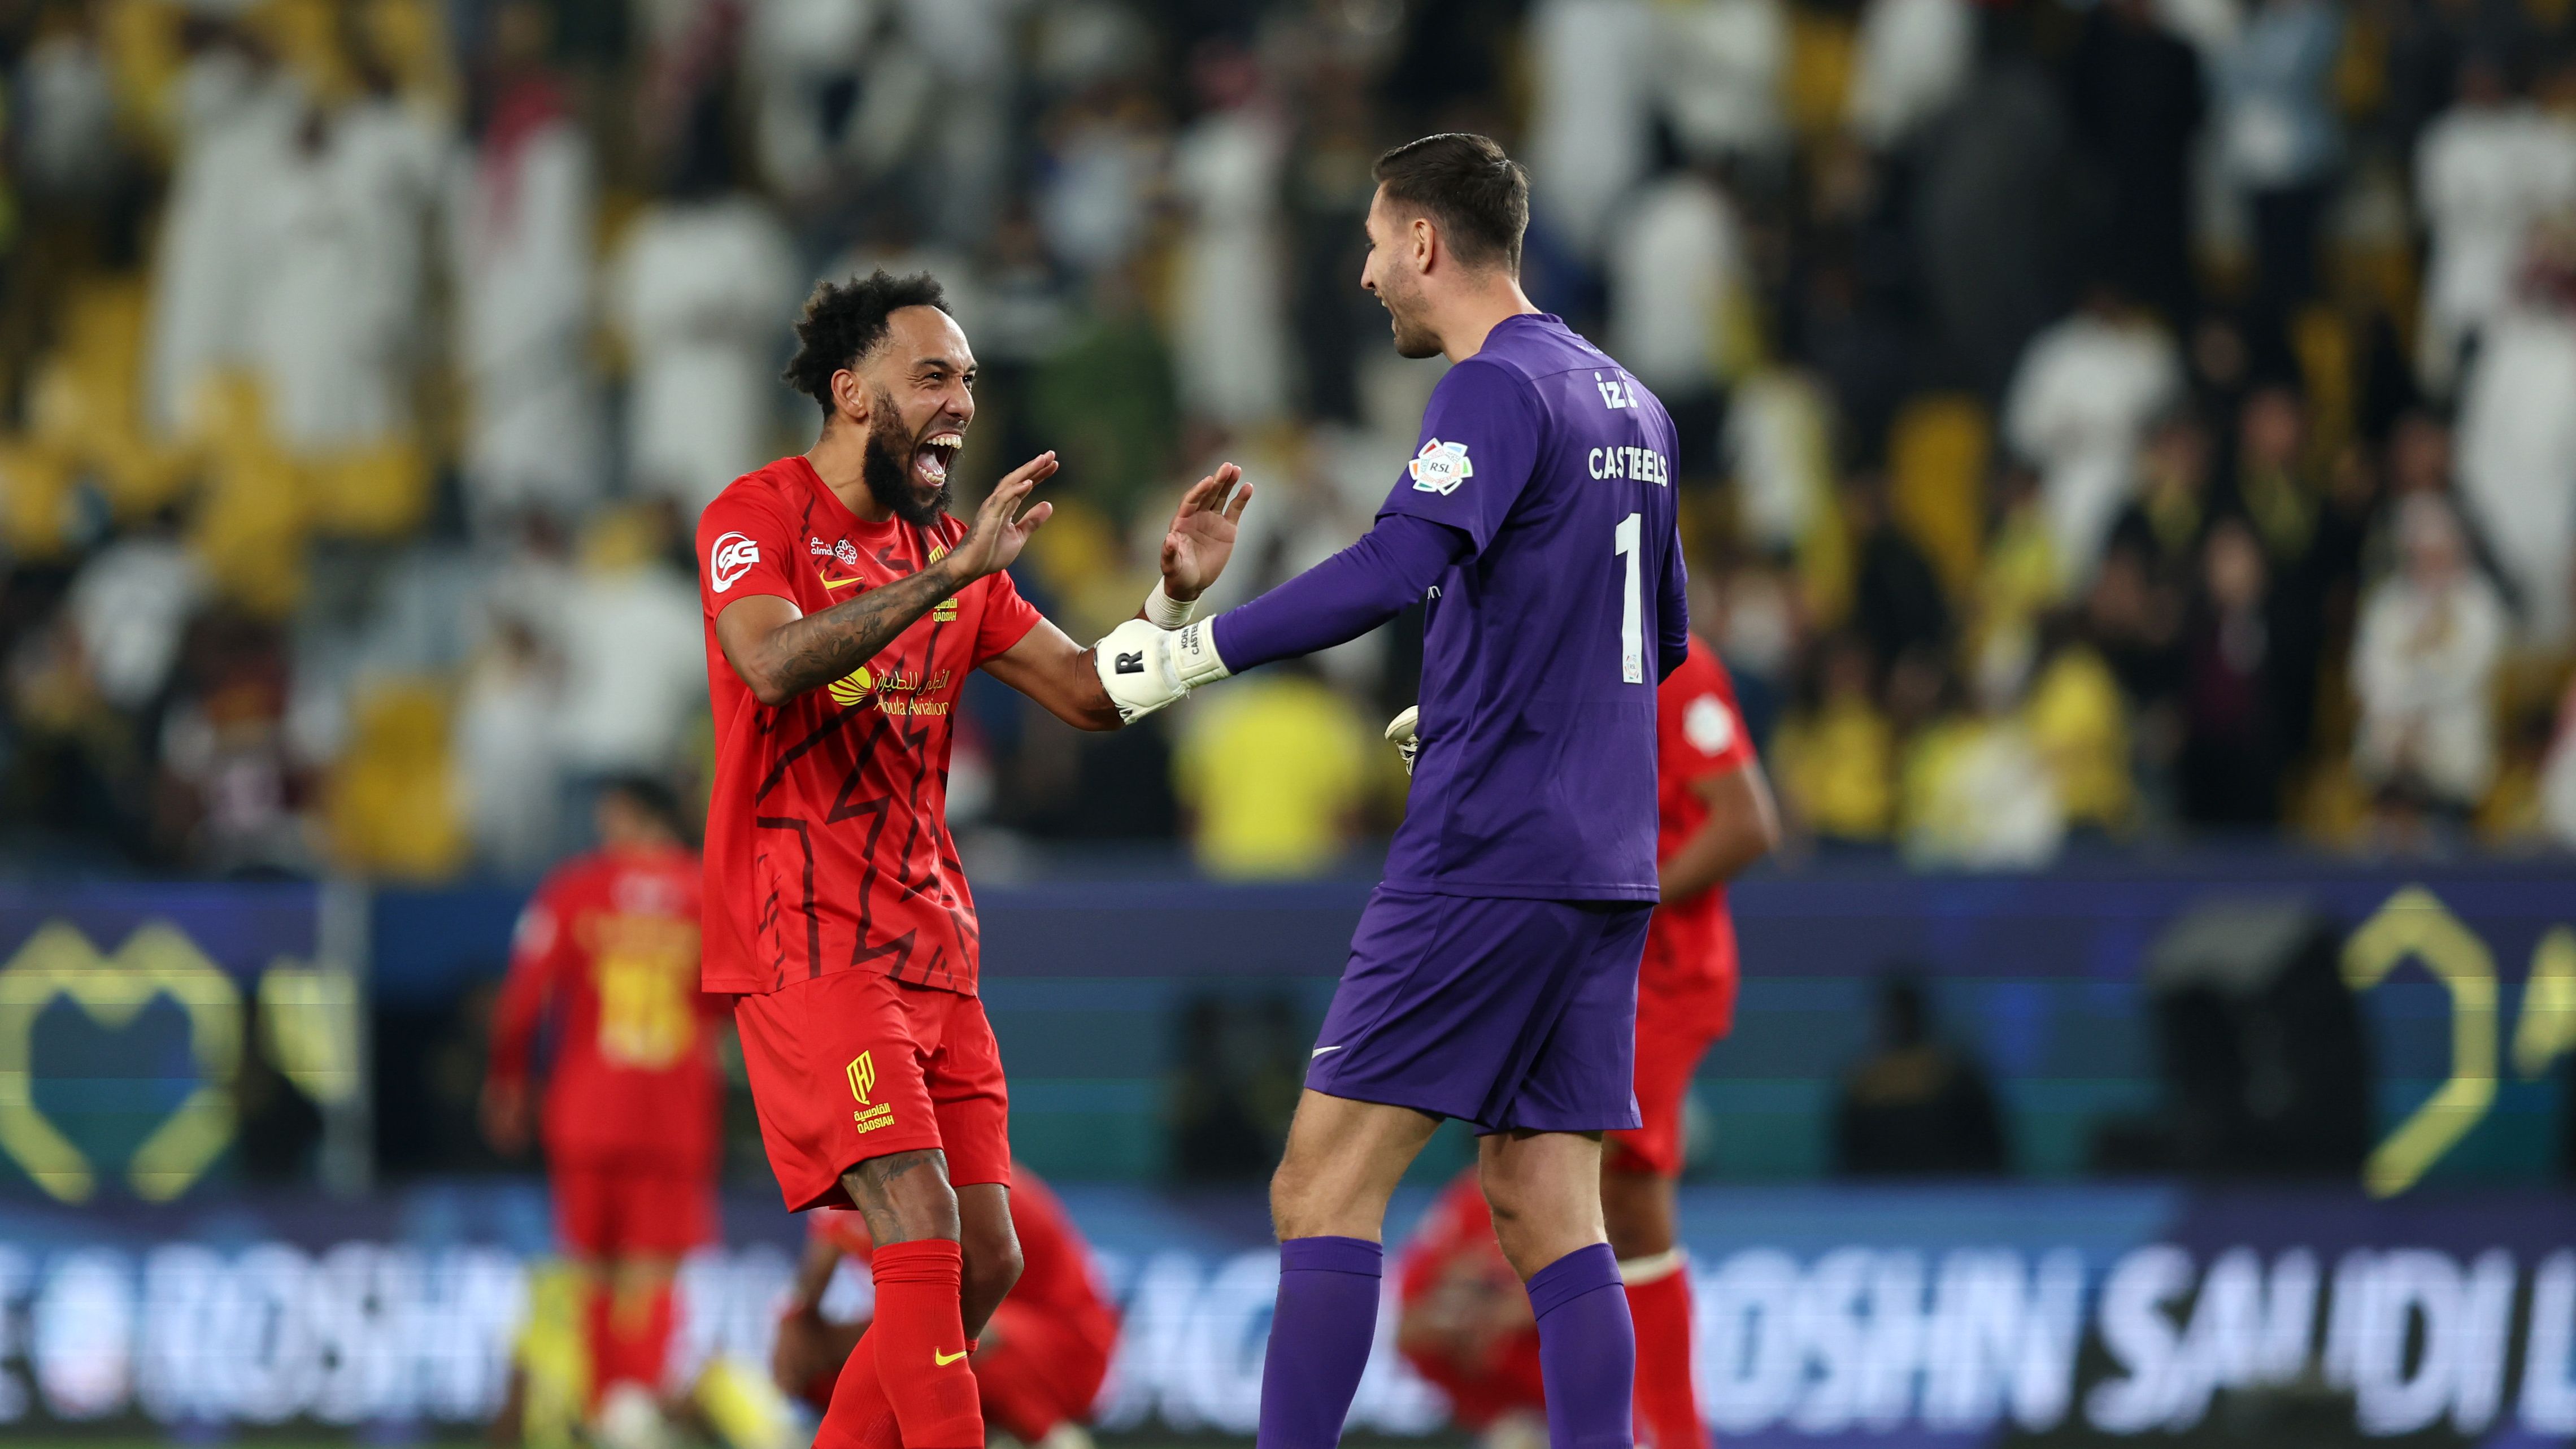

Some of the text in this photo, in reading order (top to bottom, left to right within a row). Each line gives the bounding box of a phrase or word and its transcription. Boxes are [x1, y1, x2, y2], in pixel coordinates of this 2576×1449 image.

[1430, 462, 1450, 473] RSL
[1589, 446, 1668, 487] CASTEELS
[1615, 512, 1643, 684] 1
[1115, 650, 1145, 675] R
[908, 697, 950, 716] Aviation
[854, 1102, 891, 1122] القادسية
[856, 1115, 895, 1134] QADSIAH
[2085, 1246, 2517, 1434] SAUDI
